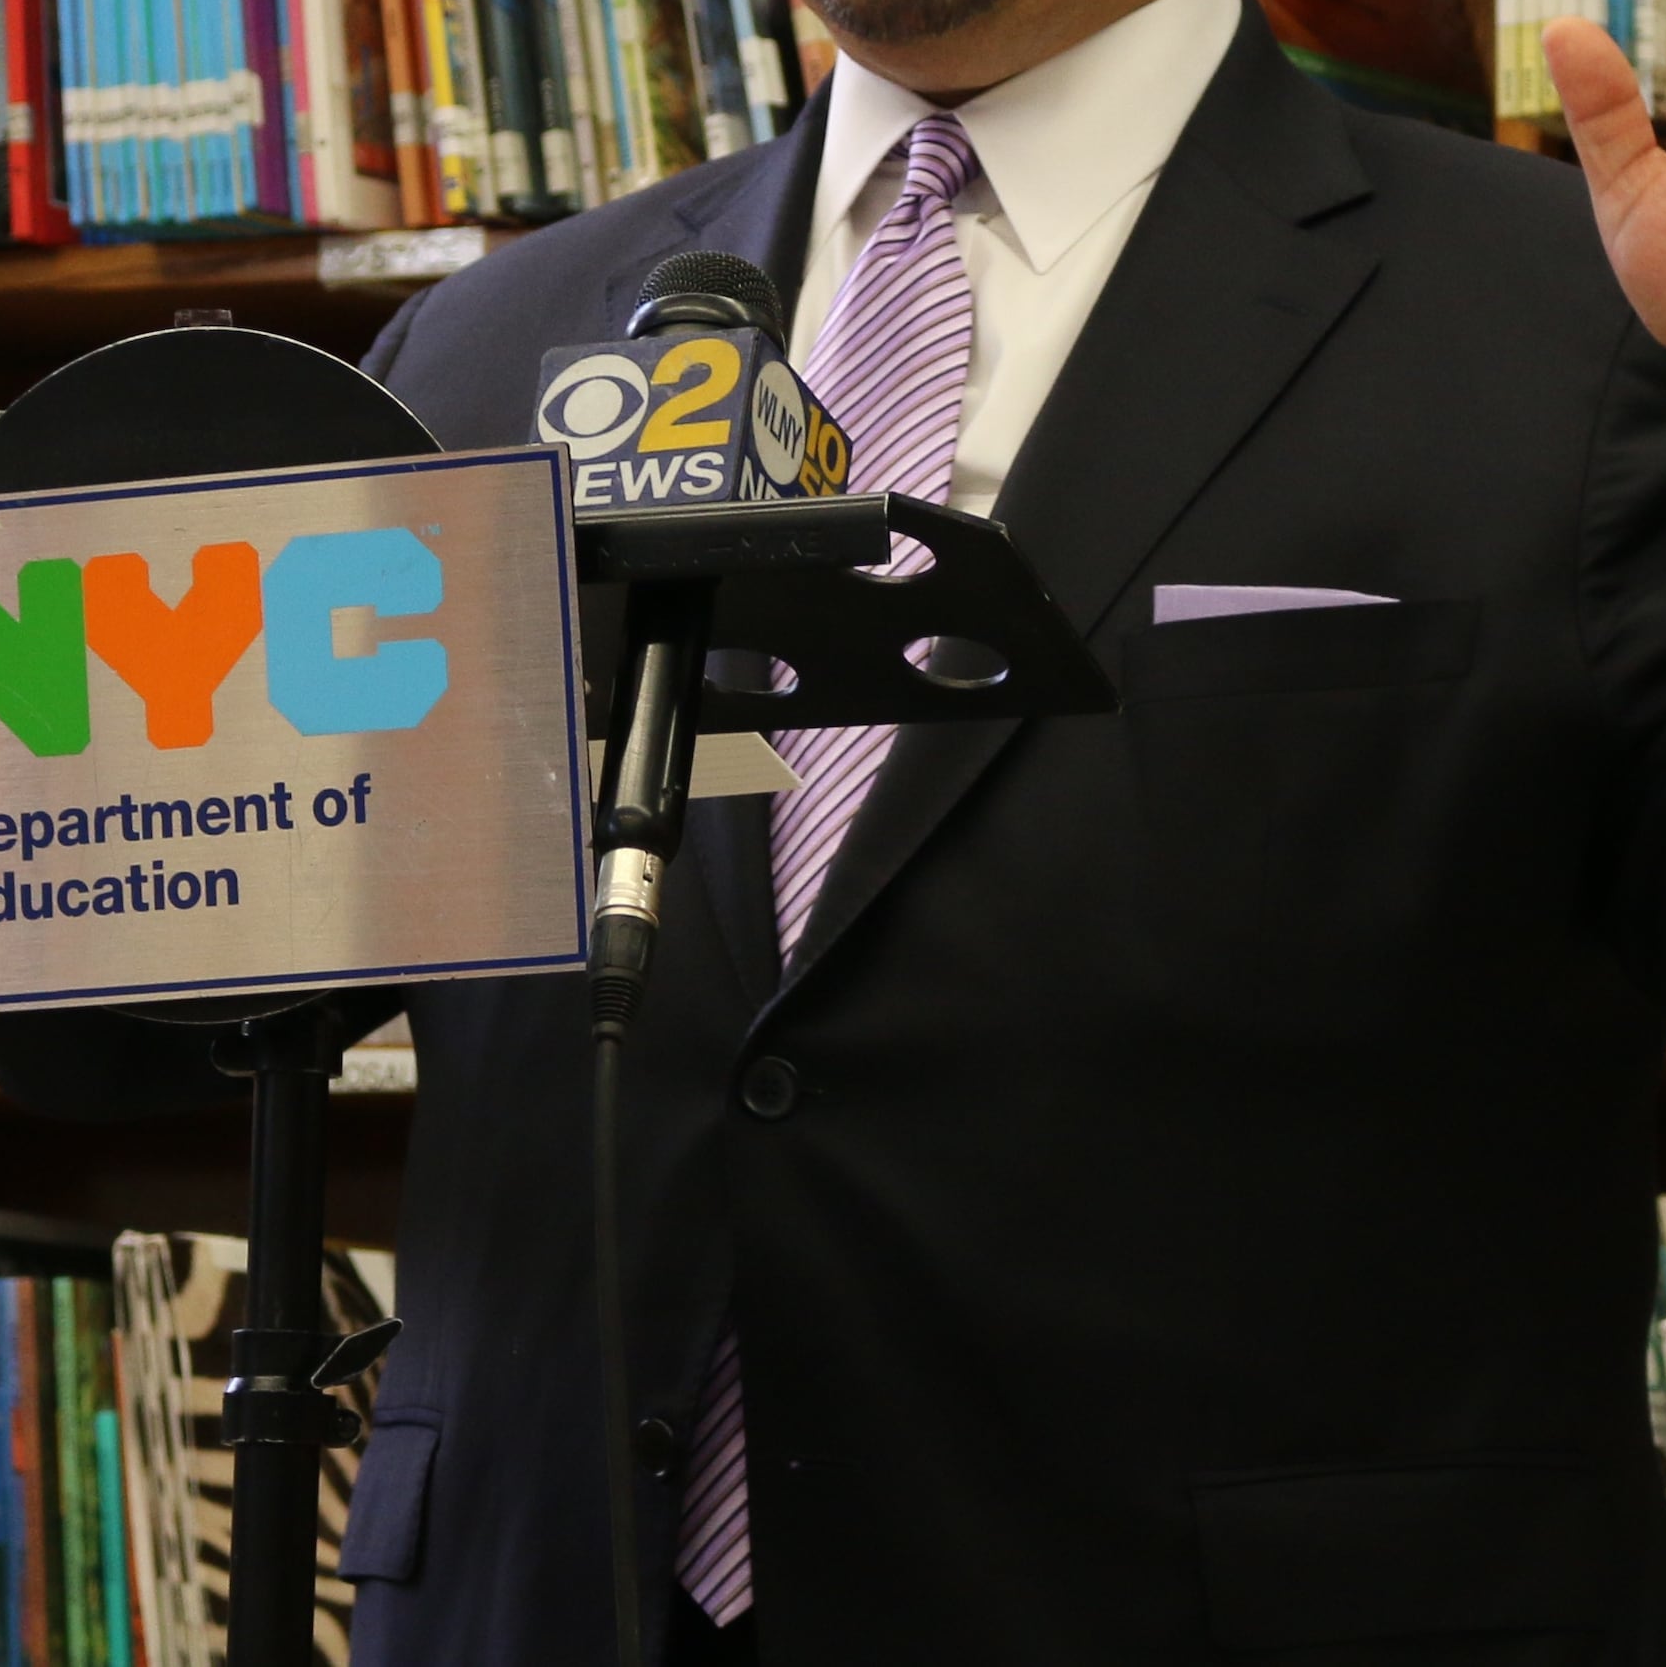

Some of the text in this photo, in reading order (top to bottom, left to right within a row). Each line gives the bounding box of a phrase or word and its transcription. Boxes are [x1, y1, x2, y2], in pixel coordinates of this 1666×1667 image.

[637, 338, 741, 453] 2
[760, 379, 805, 461] WLNY
[807, 402, 847, 485] 10
[574, 451, 726, 507] EWS
[312, 774, 372, 825] of
[337, 1061, 417, 1093] OSAU
